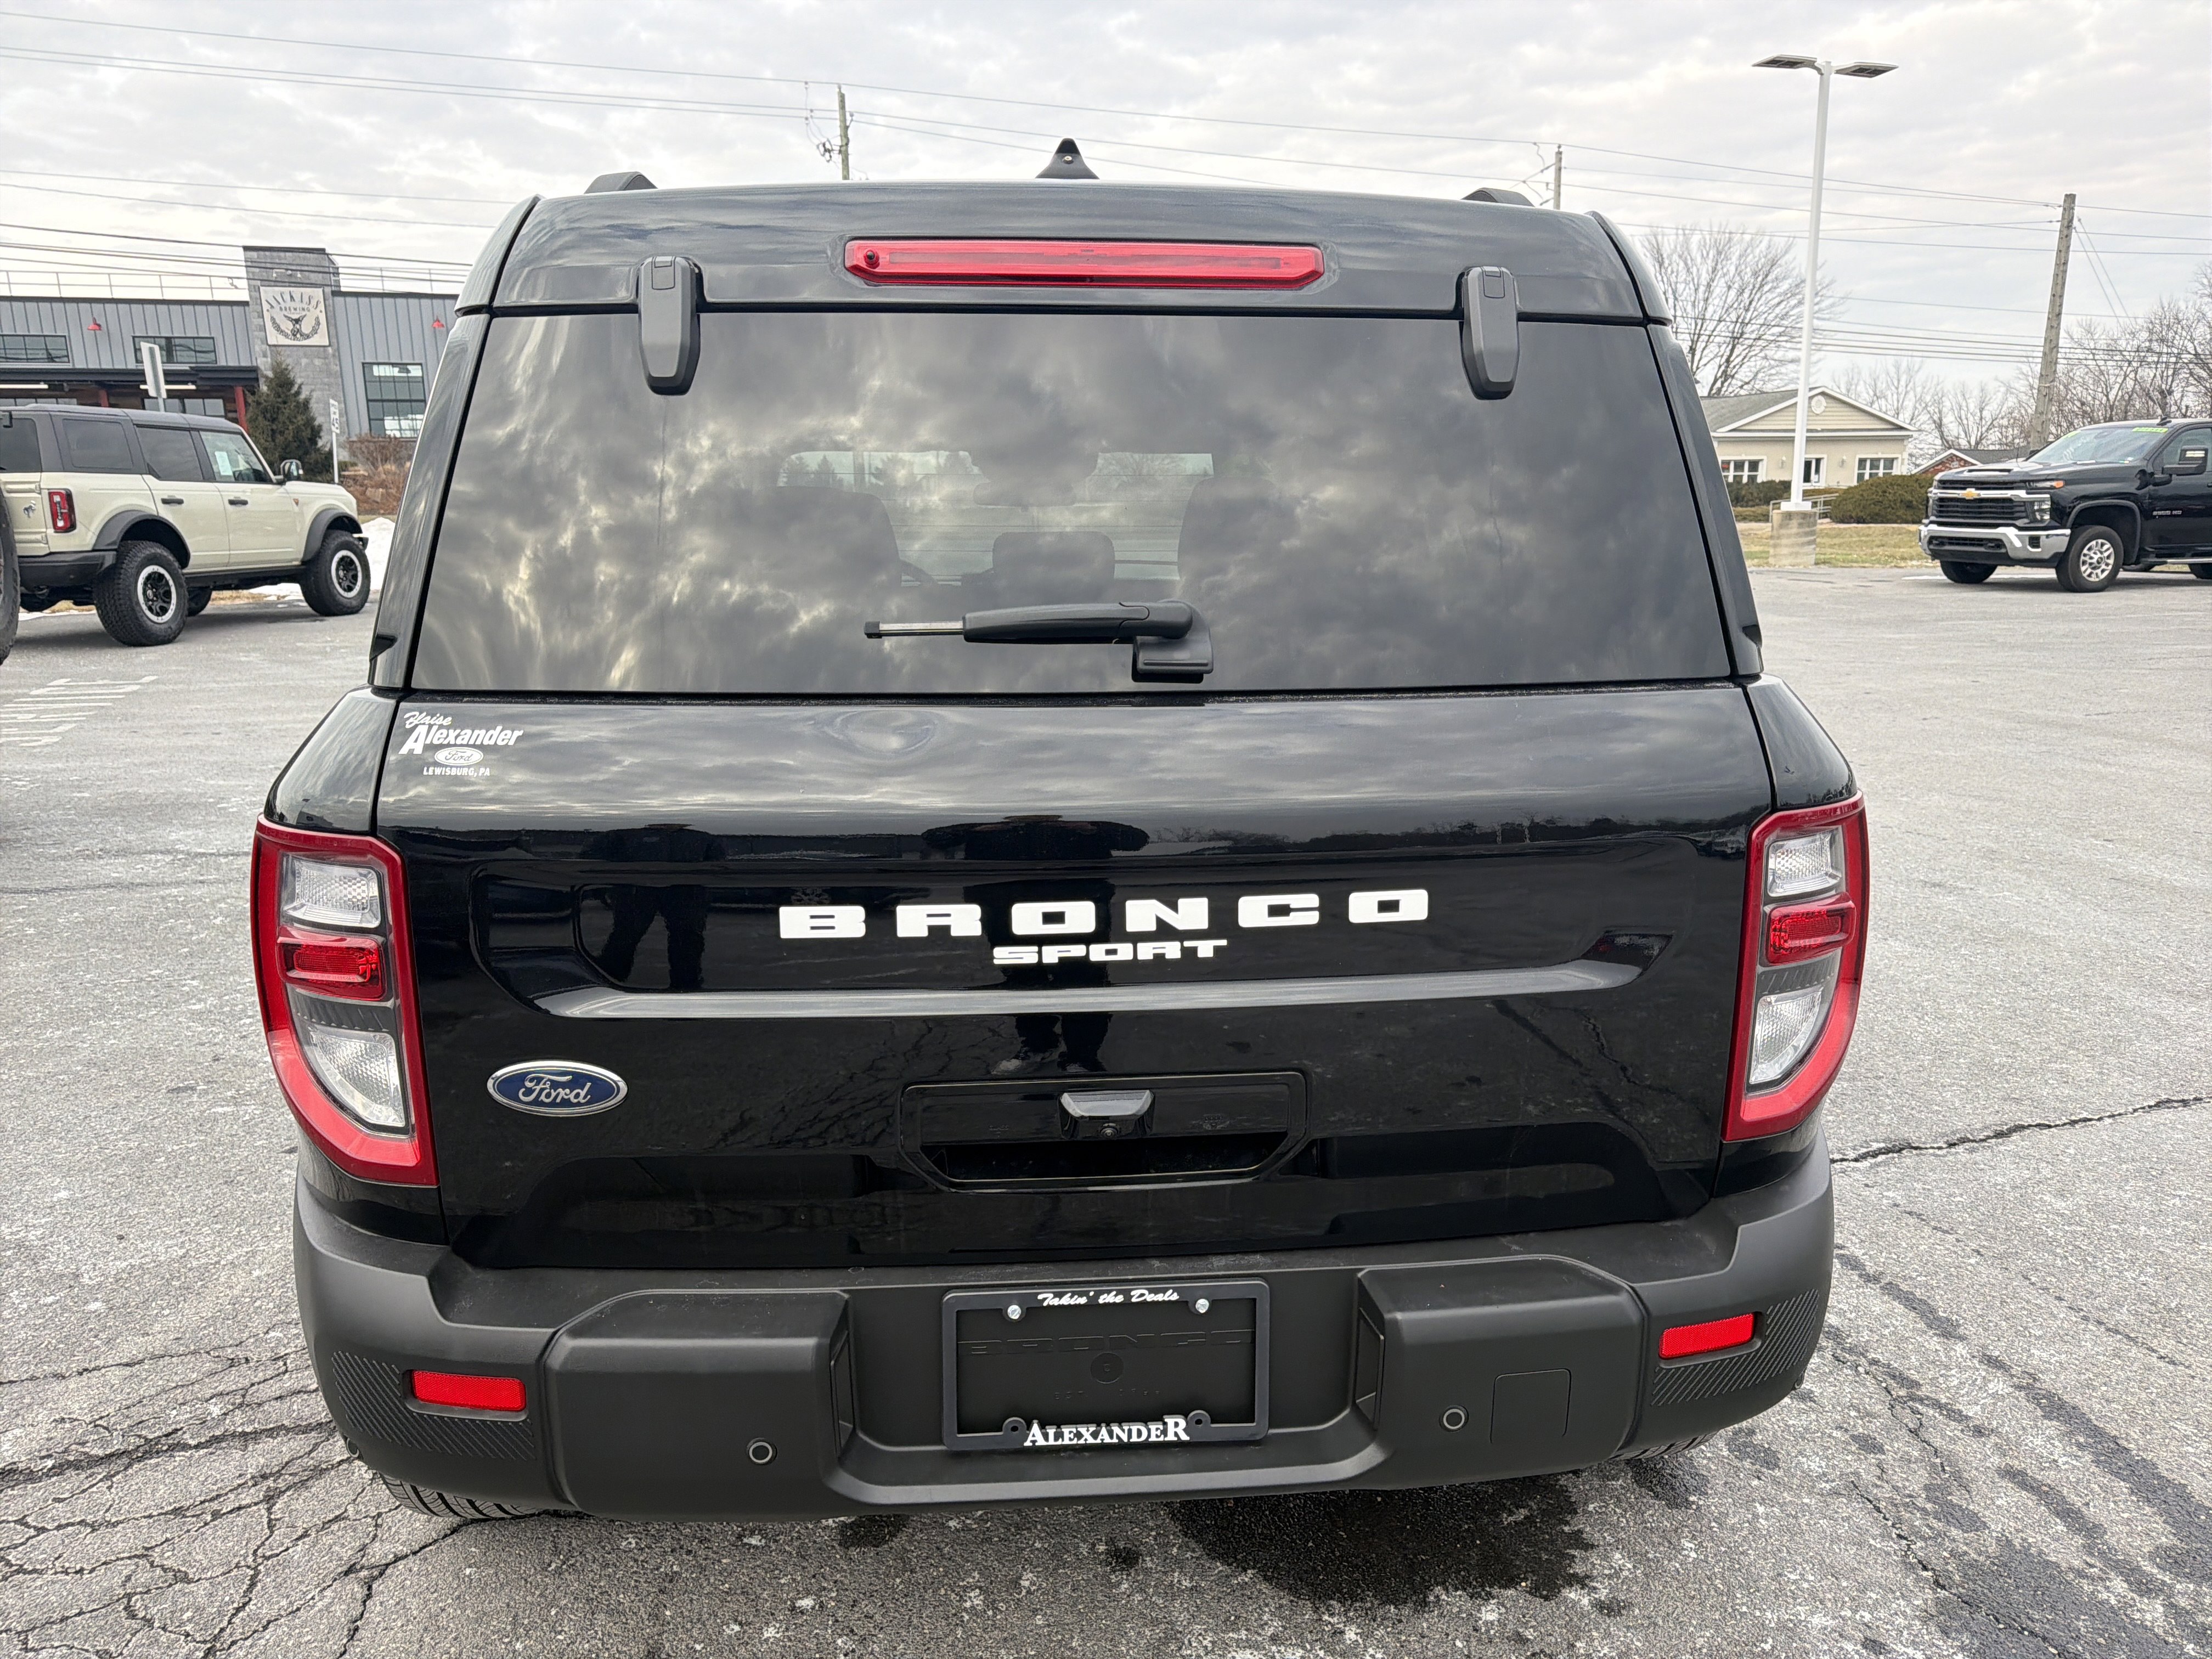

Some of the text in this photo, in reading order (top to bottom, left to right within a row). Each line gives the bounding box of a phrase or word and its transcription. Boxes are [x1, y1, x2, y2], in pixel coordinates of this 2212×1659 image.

[265, 290, 321, 309] JACKASS
[404, 712, 453, 729] Blaise
[398, 725, 524, 755] Alexander
[444, 749, 473, 761] Ford
[423, 766, 491, 777] LEWISBURG, PA
[779, 889, 1429, 939] BRONCO
[992, 939, 1228, 966] SPORT
[518, 1074, 592, 1103] Ford
[1037, 1289, 1180, 1307] Takin' the Deals
[1023, 1417, 1190, 1447] ALEXANDER
